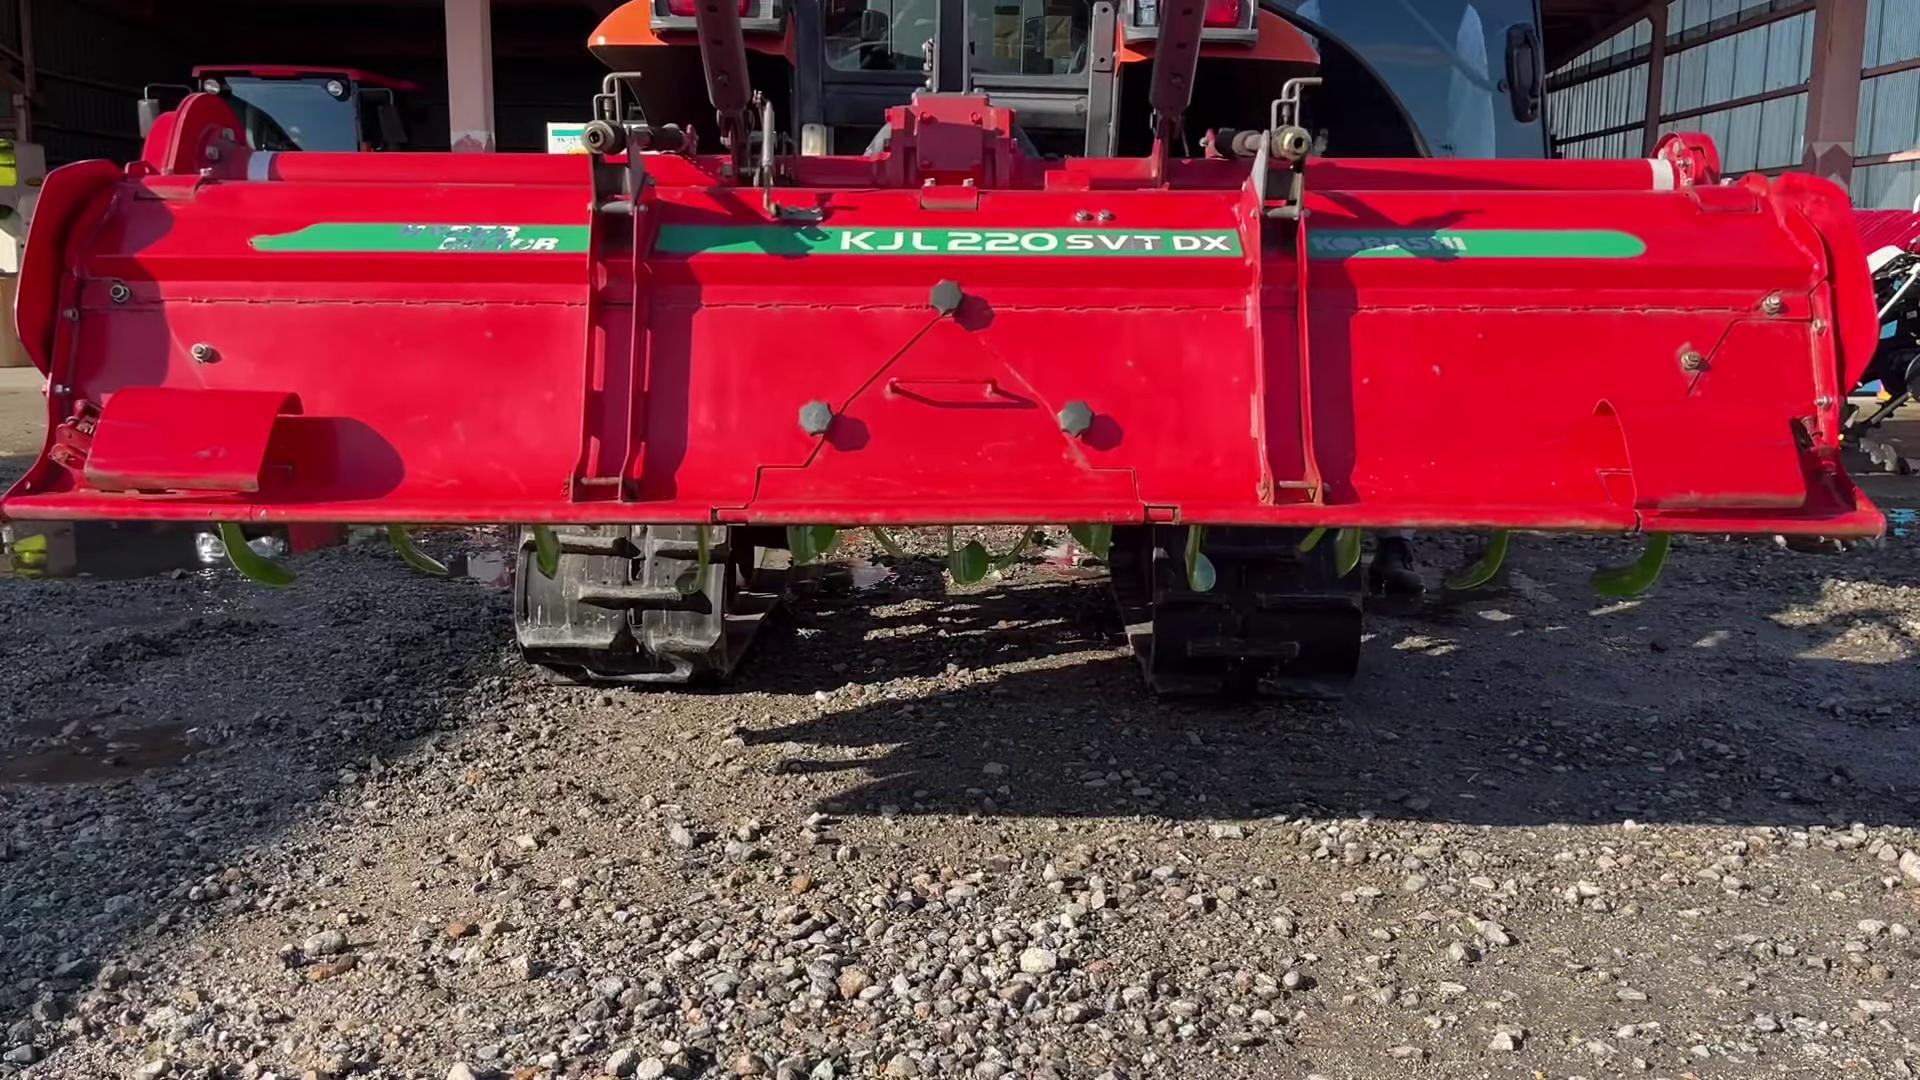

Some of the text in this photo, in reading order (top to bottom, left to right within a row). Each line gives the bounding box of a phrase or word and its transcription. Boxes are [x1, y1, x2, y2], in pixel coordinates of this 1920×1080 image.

[840, 231, 1231, 252] KJL 220 SVT DX
